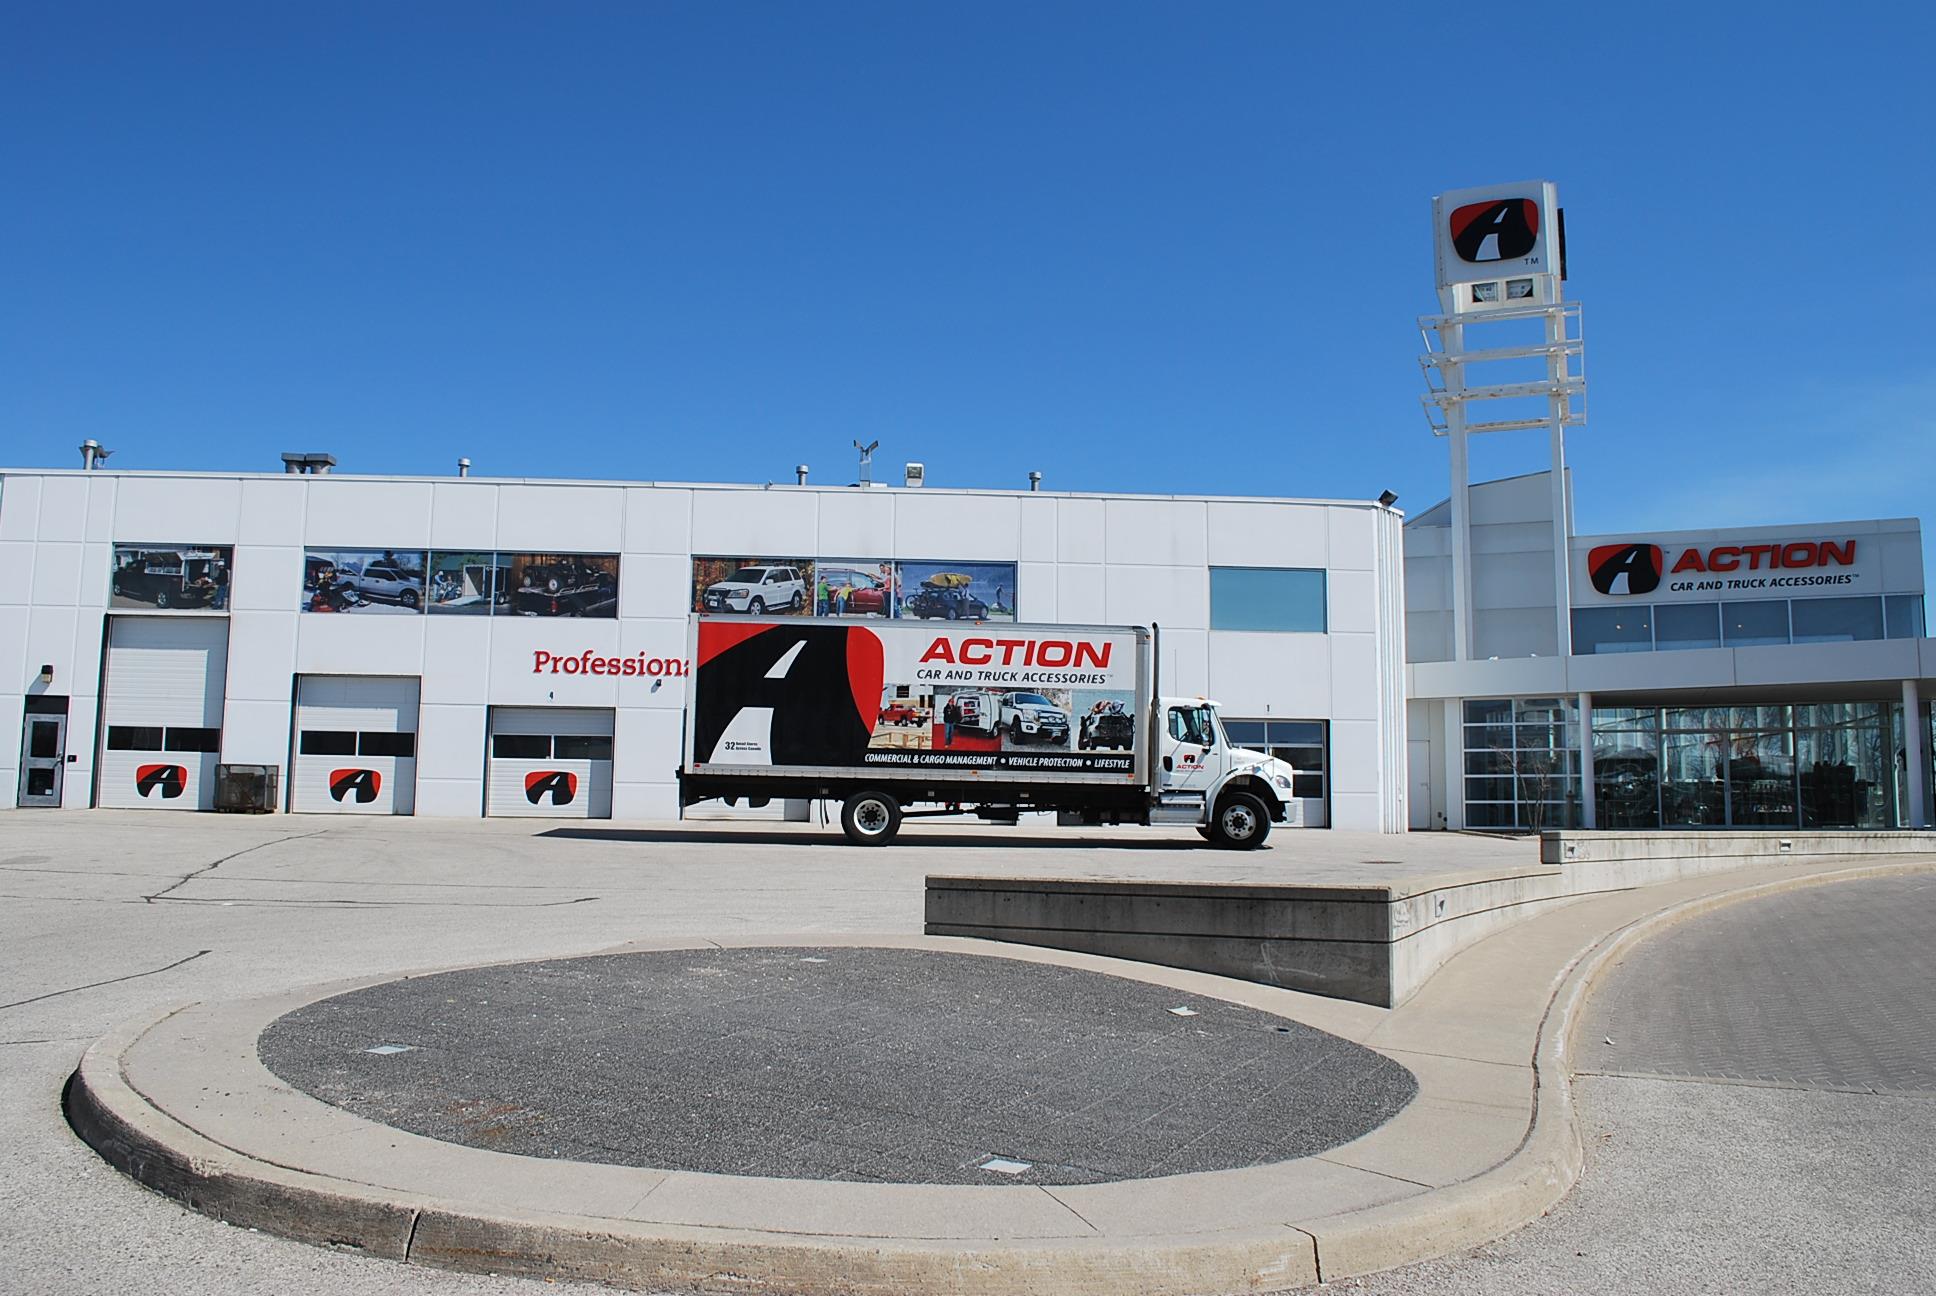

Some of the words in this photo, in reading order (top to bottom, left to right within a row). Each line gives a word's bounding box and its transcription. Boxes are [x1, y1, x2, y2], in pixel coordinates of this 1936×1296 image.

[1671, 540, 1856, 573] ACTION
[1671, 582, 1693, 592] CAR
[1696, 580, 1723, 591] AND
[1728, 578, 1767, 589] TRUCK
[919, 637, 1112, 668] ACTION
[917, 669, 942, 680] CAR
[945, 671, 973, 681] AND
[977, 671, 1018, 682] TRUCK
[725, 741, 735, 750] 32
[864, 754, 911, 763] COMMERCIAL
[920, 755, 945, 764] CARGO
[945, 756, 997, 765] MANAGEMENT
[1008, 757, 1038, 766] VEHICLE
[1039, 757, 1083, 767] PROTECTION
[1094, 759, 1130, 768] LIFESTYLE
